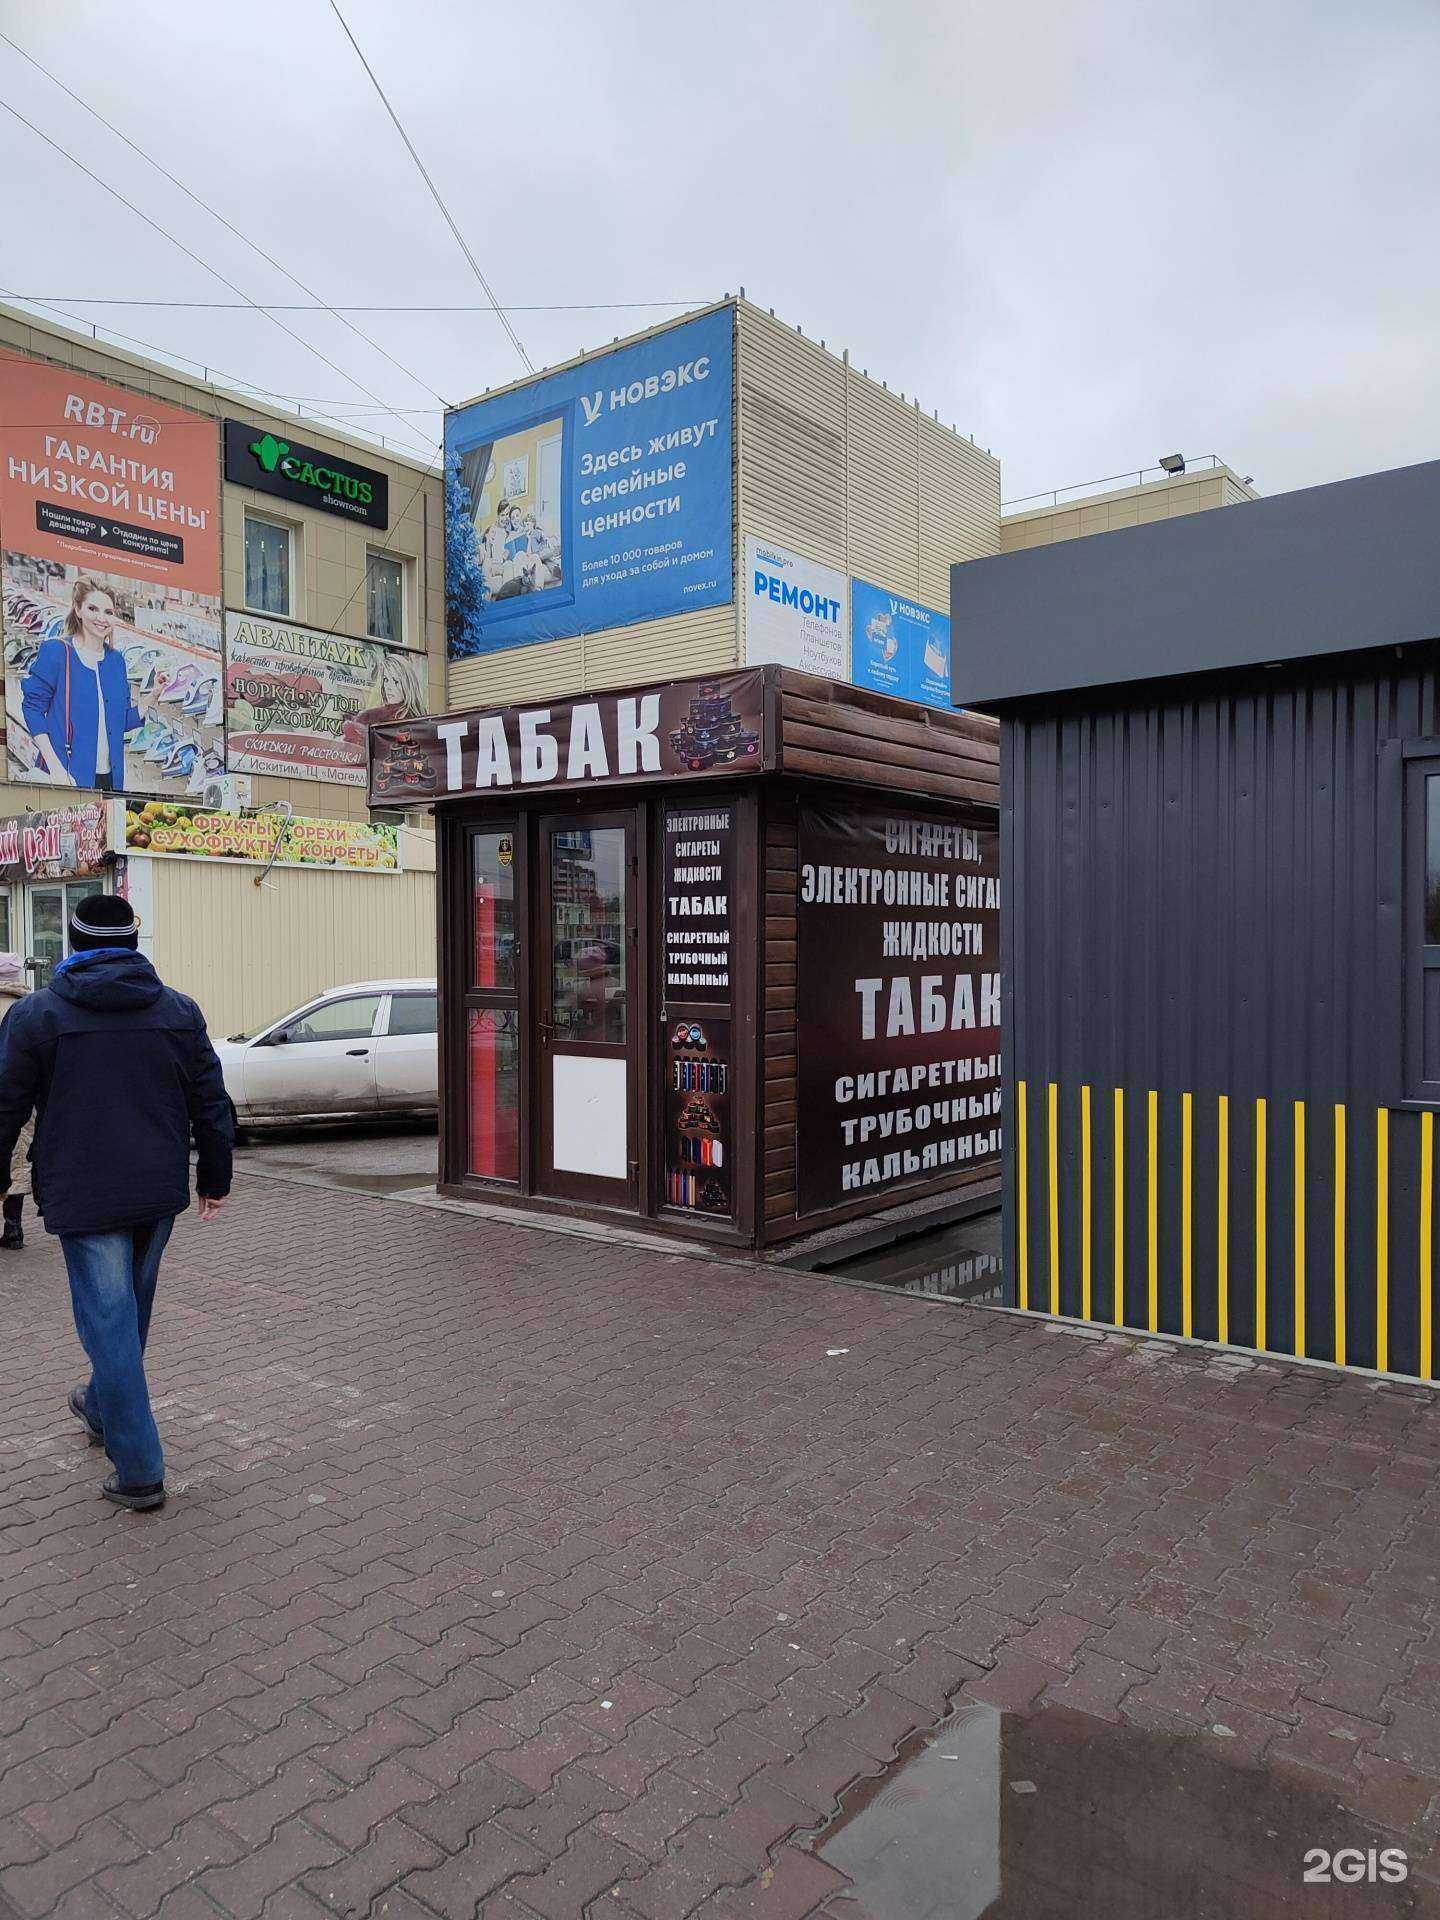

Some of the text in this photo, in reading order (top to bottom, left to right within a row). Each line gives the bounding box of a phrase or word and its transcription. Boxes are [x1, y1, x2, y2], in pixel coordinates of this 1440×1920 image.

[610, 357, 710, 411] НОВЭКС
[63, 394, 156, 445] RBT.ru
[45, 435, 175, 492] ГАРАНТИЯ
[581, 419, 718, 476] Здесь живут
[8, 457, 130, 510] НИЗКОЙ
[281, 456, 373, 504] CACTUS
[580, 461, 687, 505] семейные
[41, 508, 97, 531] Нашли товар
[322, 493, 368, 516] showroom
[581, 495, 681, 538] ценности
[49, 521, 89, 536] дешевле?
[112, 526, 178, 549] Отдадим по цене
[581, 540, 683, 572] Более 10 000 товаров
[582, 549, 714, 589] для ухода за собой и домом
[683, 579, 717, 594] novex.ru
[754, 570, 841, 623] РЕМОНТ
[802, 616, 842, 639] Телефонов
[900, 602, 931, 624] НОВЭКС
[234, 621, 367, 669] АВАНТАЖ
[800, 629, 842, 652] Планшетов
[803, 644, 842, 666] Ноутбуков
[235, 677, 360, 715] НОРКА МУТОН
[437, 693, 662, 792] ТАБАК
[304, 764, 318, 779] ТЦ
[193, 815, 346, 841] ФРУКТЫ ОРЕХИ
[666, 813, 730, 833] ЭЛЕКТРОННЫЕ
[153, 829, 379, 861] СУХОФРУКТЫ КОНФЕТЫ
[675, 840, 720, 858] СИГАРЕТЫ
[885, 818, 982, 866] СИГАРЕТЫ,
[673, 866, 722, 884] ЖИДКОСТИ
[801, 864, 949, 907] ЭЛЕКТРОННЫЕ
[668, 896, 728, 916] ТАБАК
[666, 930, 730, 944] СИГАРЕТНЫЙ
[882, 921, 983, 961] ЖИДКОСТИ
[669, 951, 728, 965] ТРУБОЧНЫЙ
[667, 972, 729, 986] КАЛЬЯННЫЙ
[855, 973, 1001, 1040] ТАБАК
[835, 1054, 1001, 1103] СИГАРЕТНЫ
[842, 1127, 1001, 1191] КАЛЬЯННЫ
